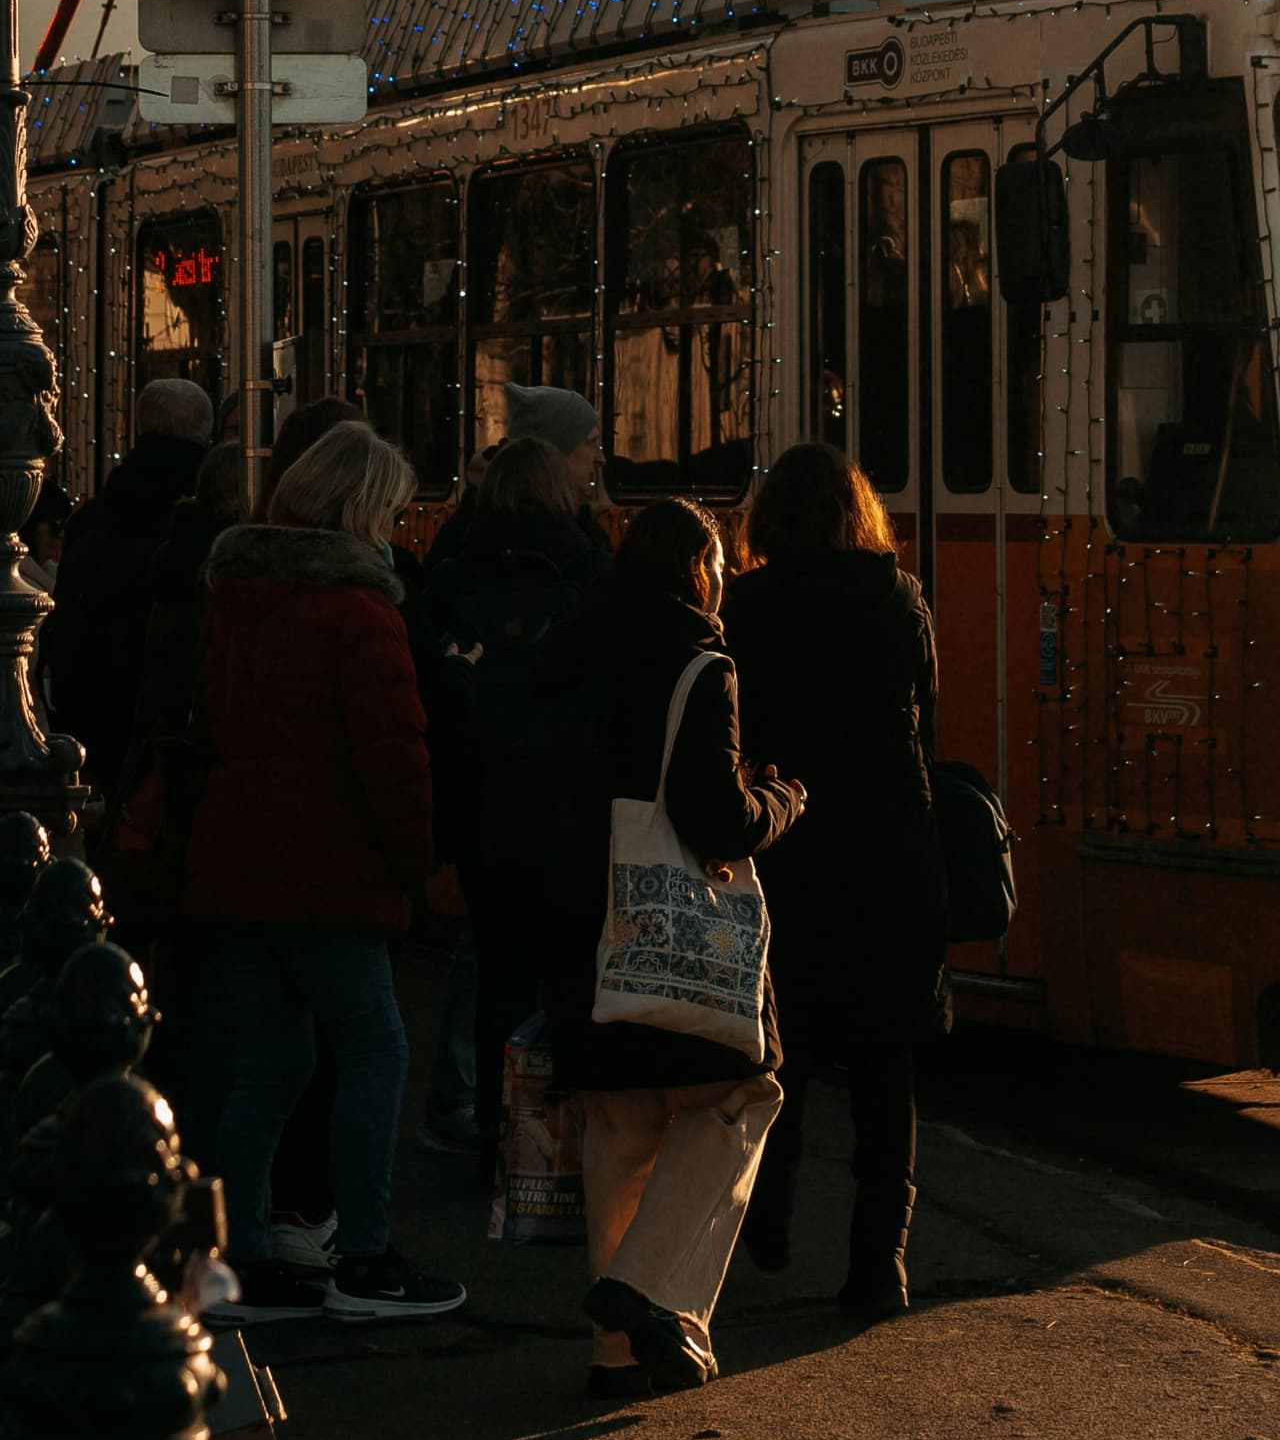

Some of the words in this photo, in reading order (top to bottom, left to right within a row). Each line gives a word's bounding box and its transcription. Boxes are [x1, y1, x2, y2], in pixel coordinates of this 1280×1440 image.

[910, 31, 958, 49] BUDAPESTI
[852, 57, 878, 76] BKK
[910, 67, 952, 83] KÖZPONT
[510, 98, 552, 141] 1347
[1144, 708, 1169, 724] BKV
